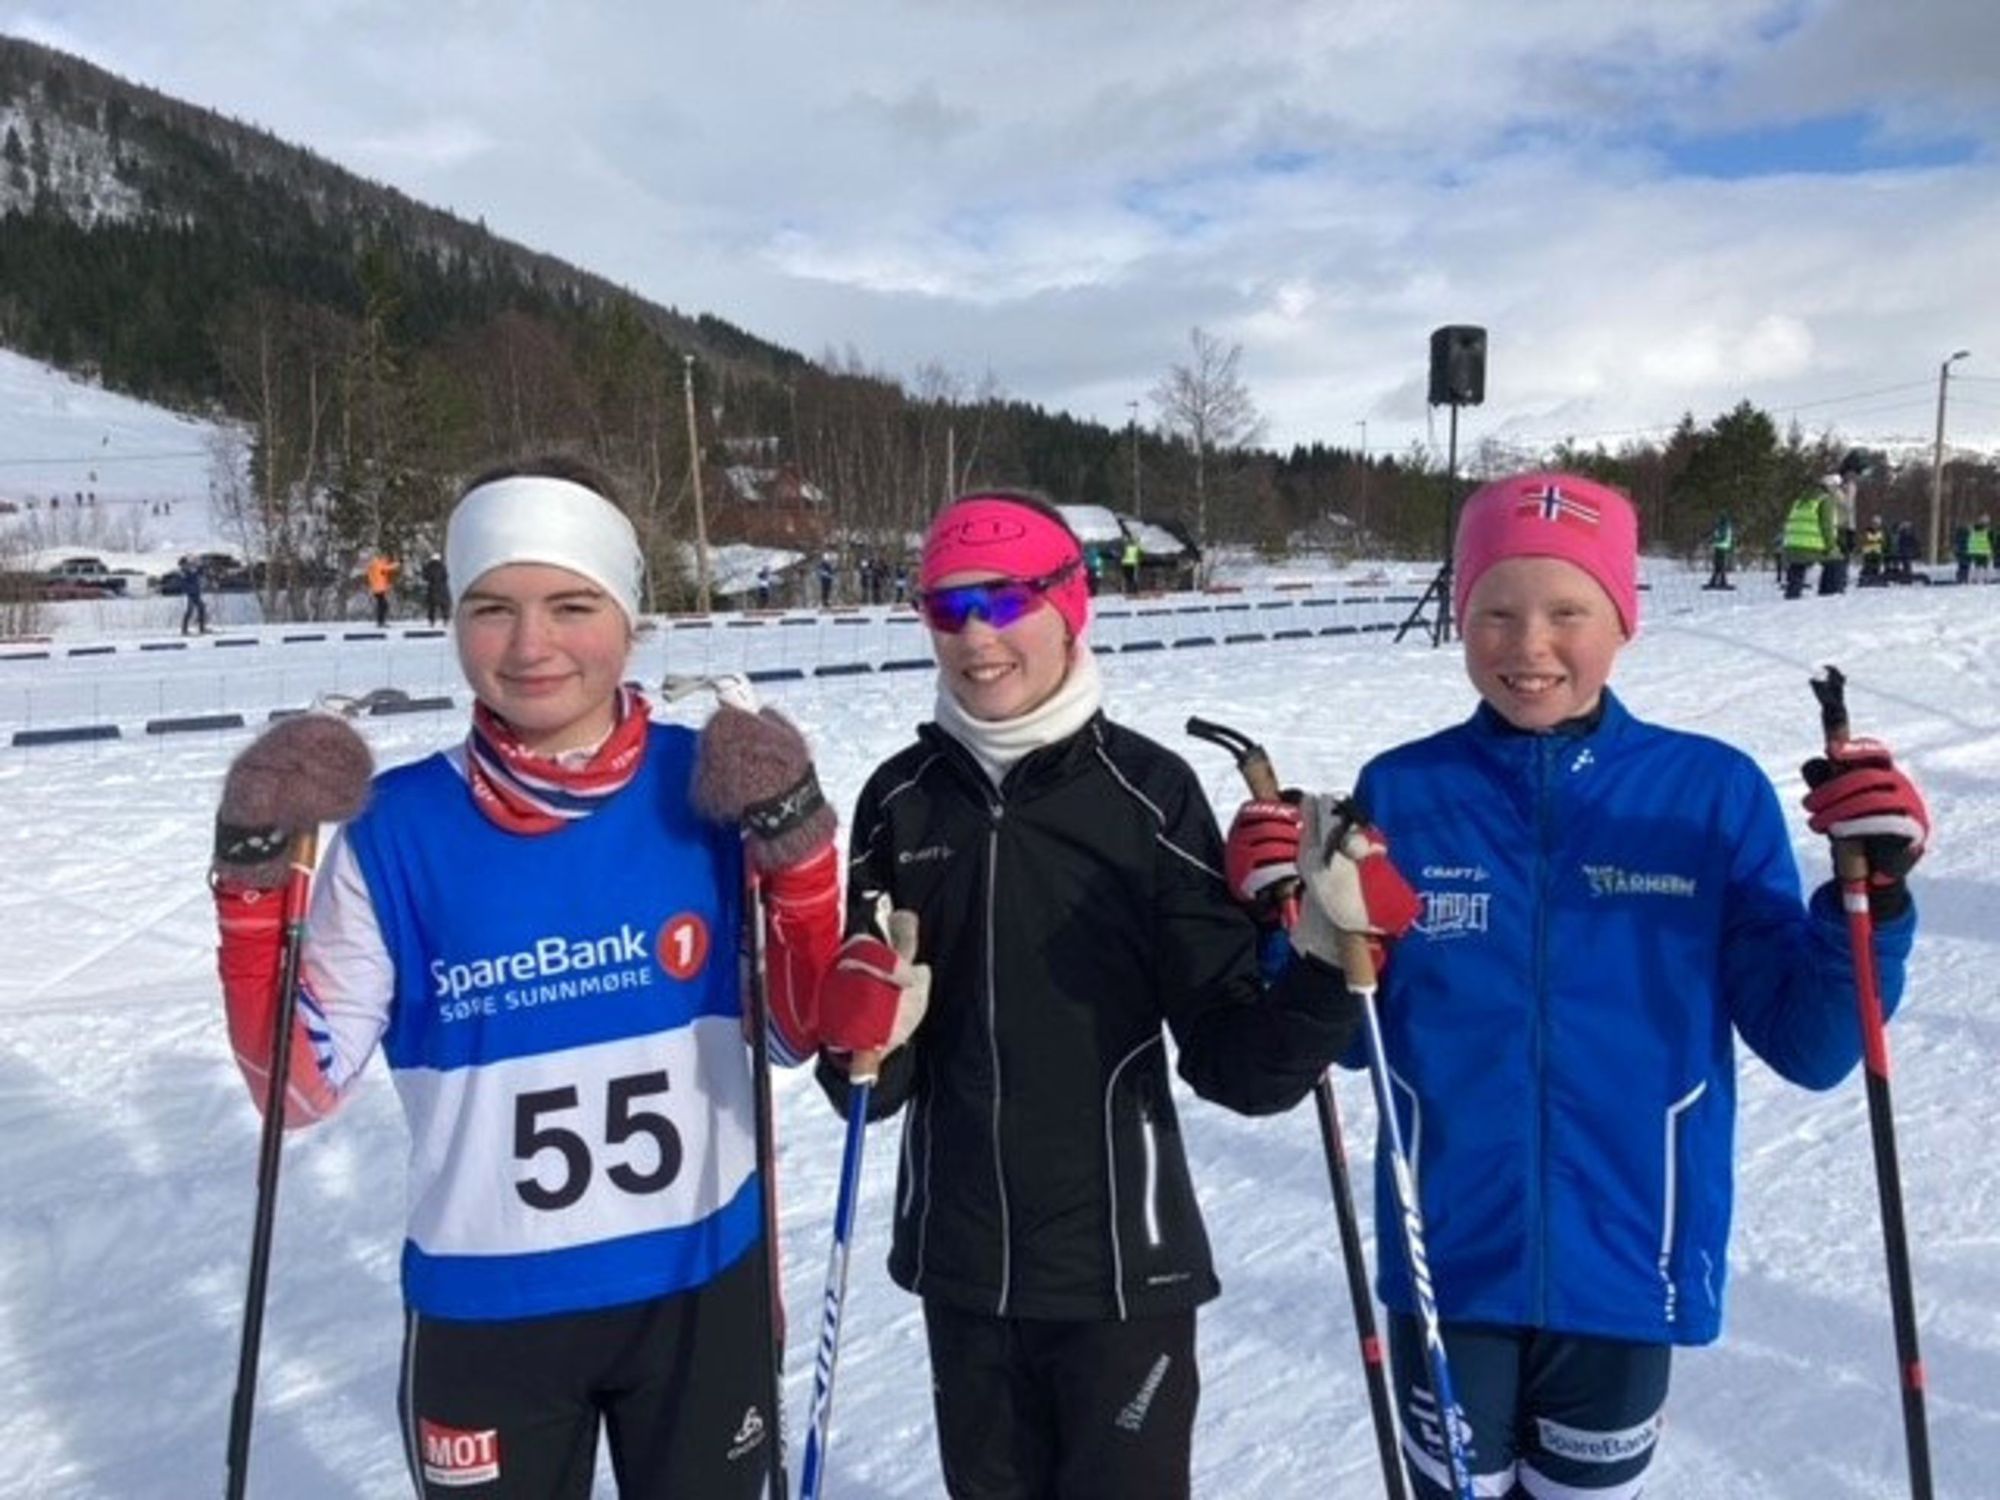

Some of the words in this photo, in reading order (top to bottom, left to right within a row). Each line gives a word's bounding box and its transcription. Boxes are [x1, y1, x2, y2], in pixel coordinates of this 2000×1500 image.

[430, 924, 648, 999] SpareBank
[673, 924, 694, 968] 1
[504, 966, 652, 1010] SUNNMØRE
[514, 1070, 683, 1212] 55
[427, 1428, 497, 1467] MOT
